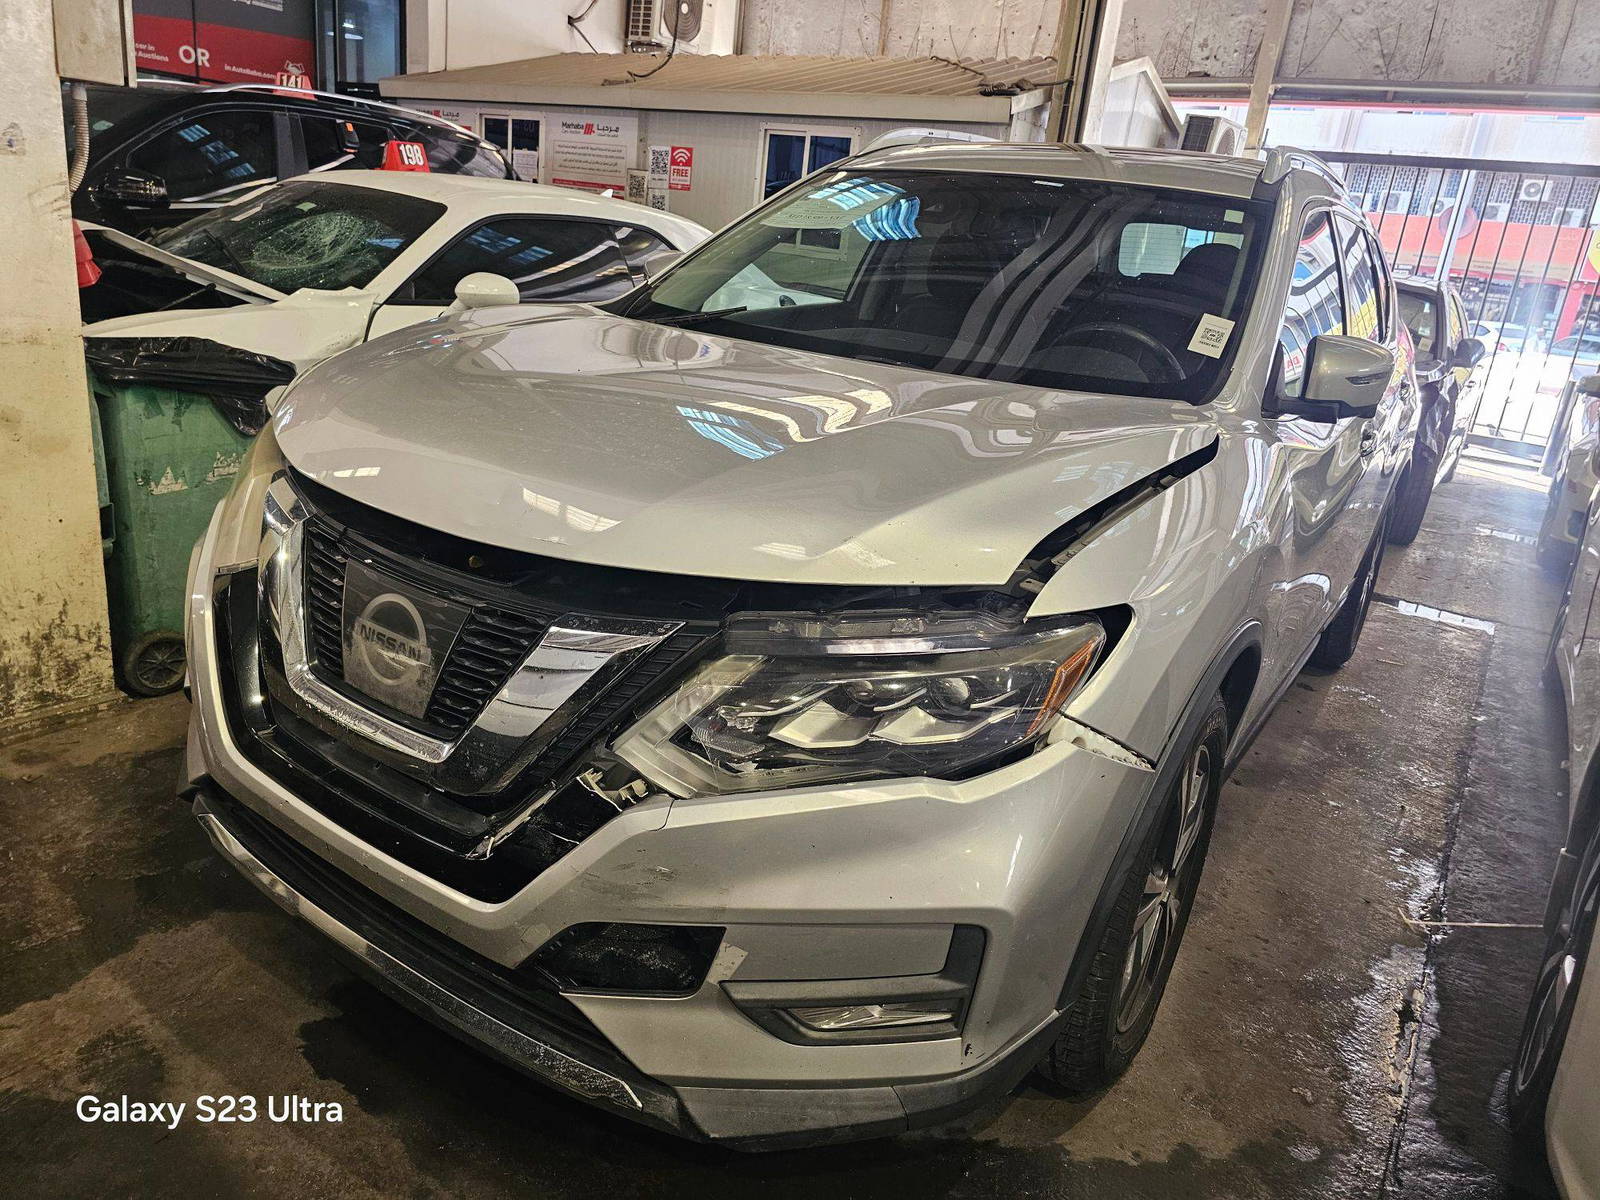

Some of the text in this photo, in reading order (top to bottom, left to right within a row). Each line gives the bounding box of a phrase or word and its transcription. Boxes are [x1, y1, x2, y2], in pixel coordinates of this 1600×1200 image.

[178, 45, 210, 68] OR
[281, 75, 304, 89] 141
[399, 143, 424, 166] 198
[672, 168, 689, 178] FREE
[360, 624, 421, 660] NISSAN
